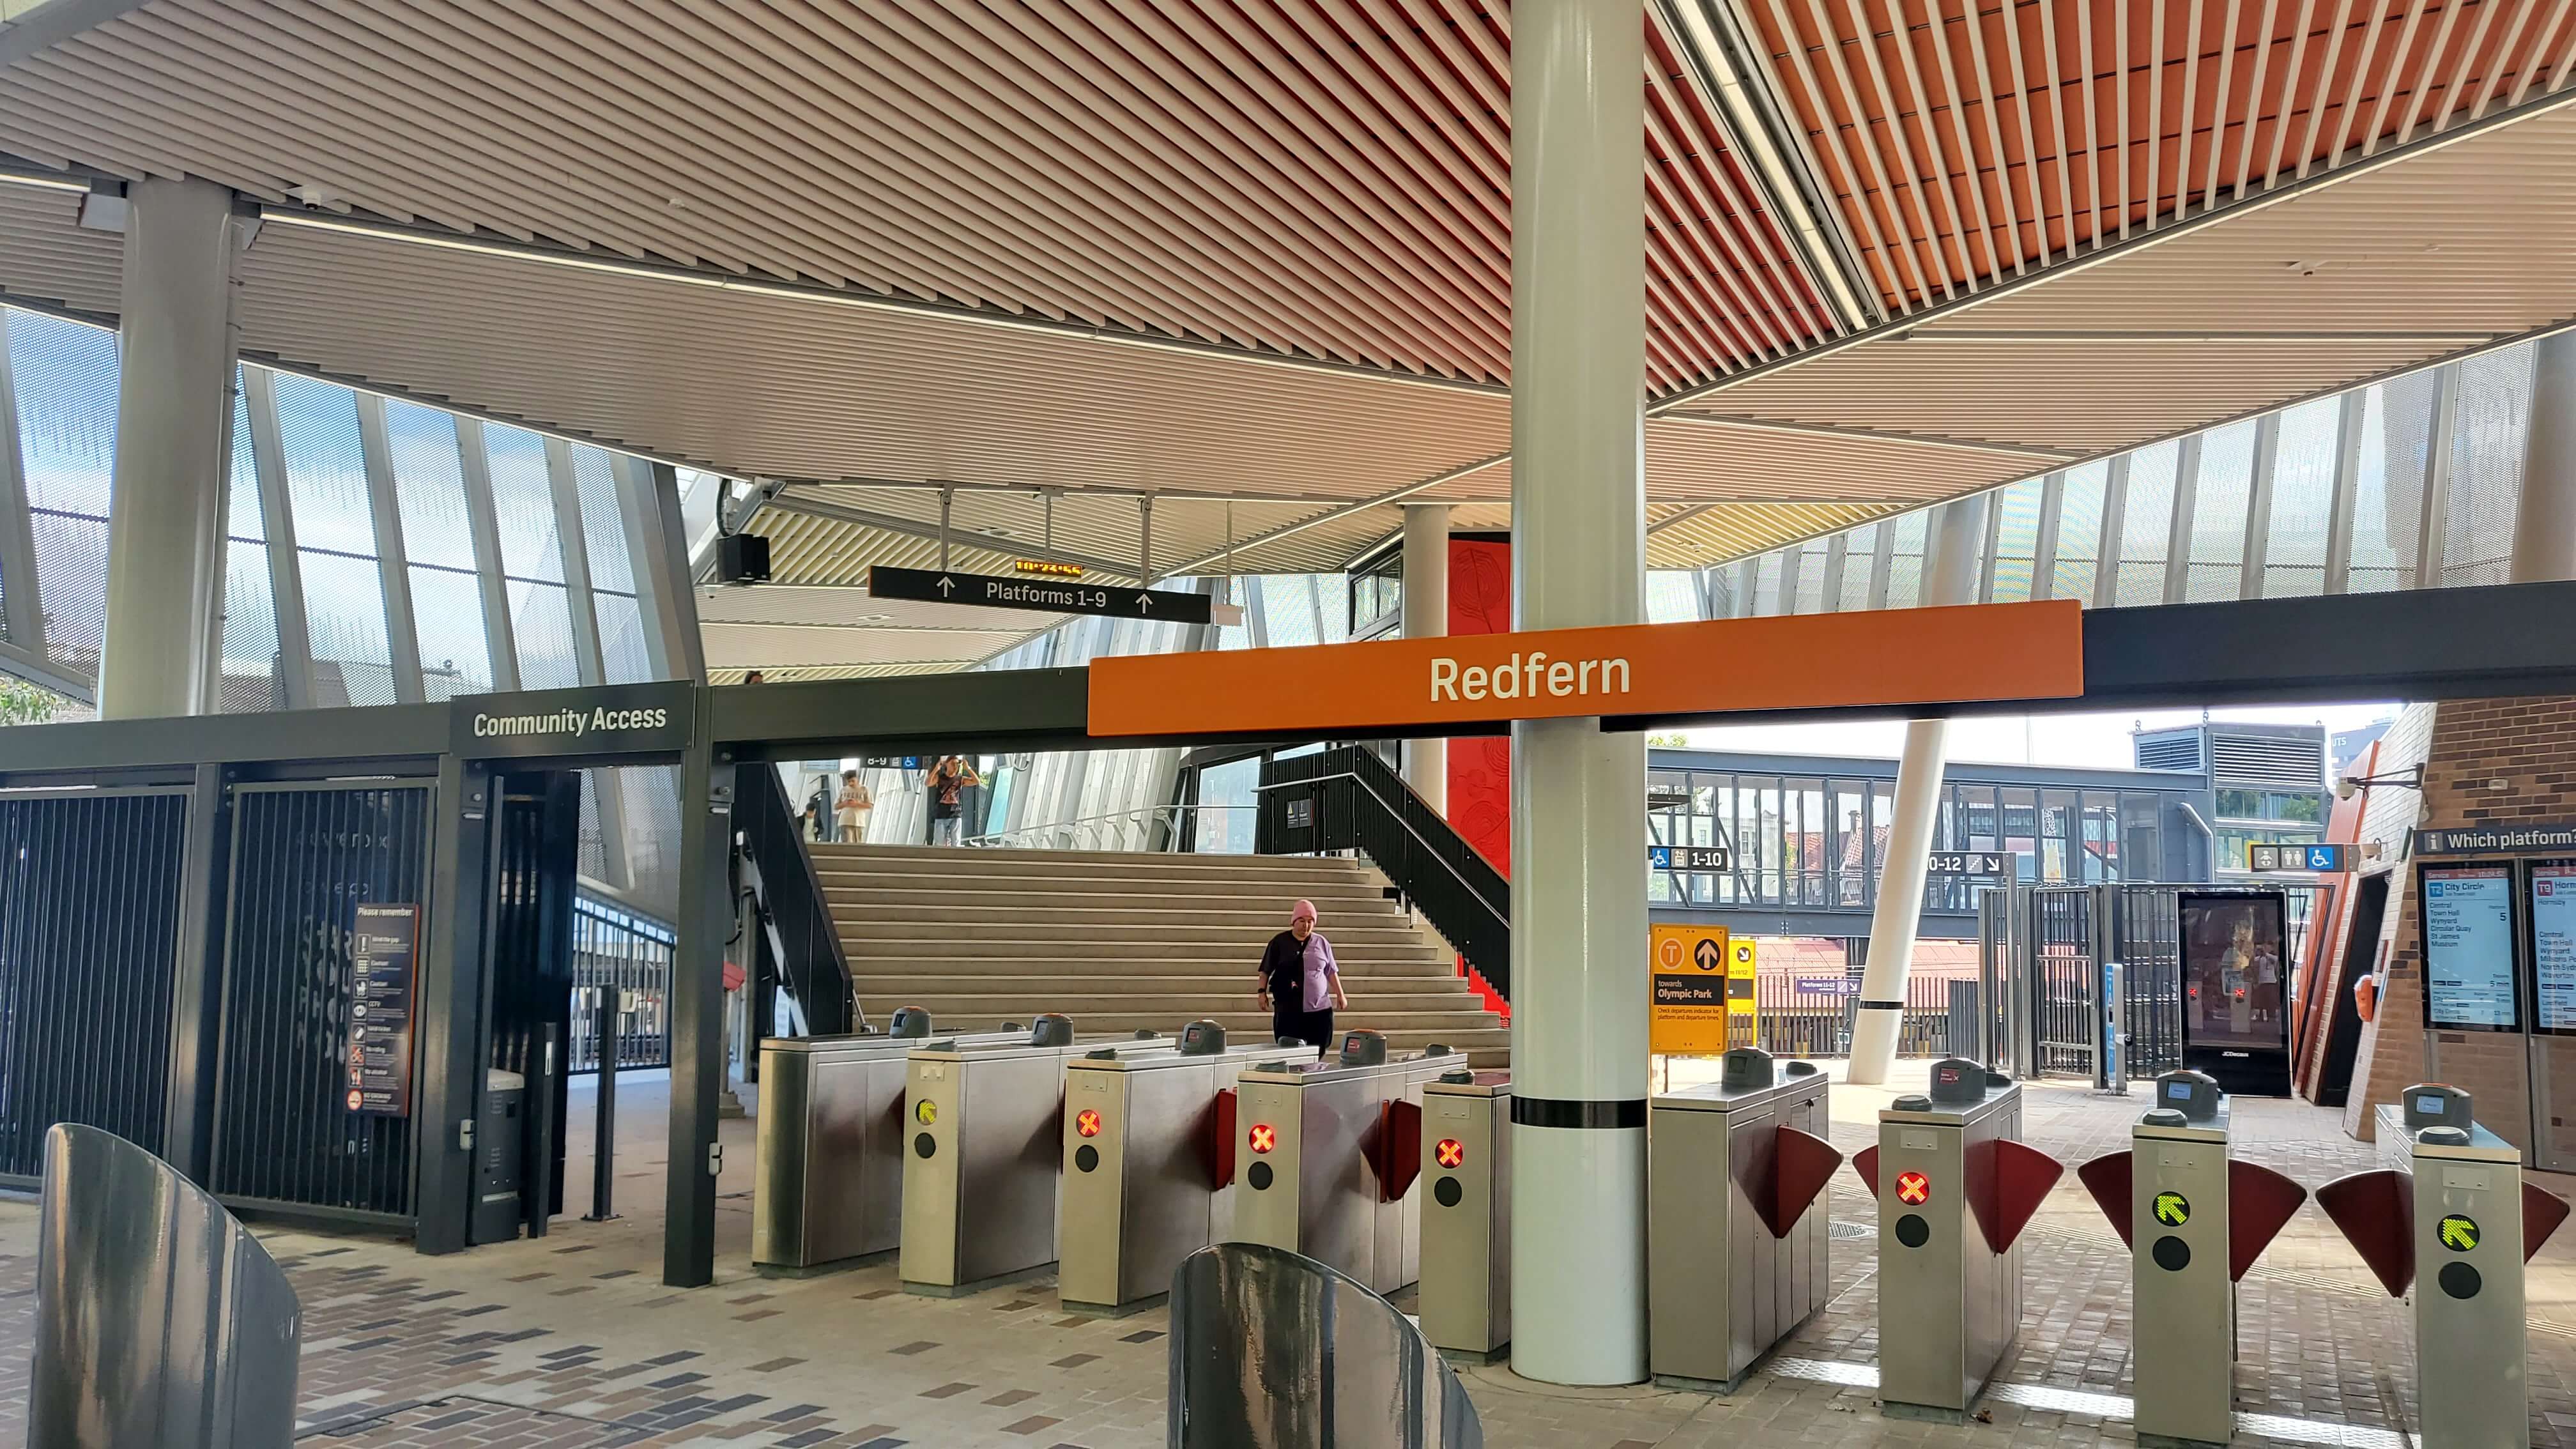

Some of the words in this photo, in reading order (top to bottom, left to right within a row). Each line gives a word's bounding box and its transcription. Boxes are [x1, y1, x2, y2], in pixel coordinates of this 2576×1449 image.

[986, 581, 1073, 605] Platforms
[1077, 590, 1107, 608] 1-9
[1430, 652, 1630, 702] Redfern
[473, 708, 588, 737] Community
[591, 707, 667, 731] Access
[2332, 737, 2347, 747] UTS
[2448, 833, 2496, 848] Which
[1692, 852, 1722, 866] 1-10
[1927, 856, 1961, 871] 0-12
[2445, 883, 2460, 891] City
[2538, 884, 2551, 893] T9
[357, 907, 379, 917] Please
[379, 907, 414, 917] remember
[2499, 912, 2507, 921] 5
[1666, 945, 1677, 963] T
[1658, 988, 1692, 1000] Olympic
[1693, 988, 1712, 999] Park
